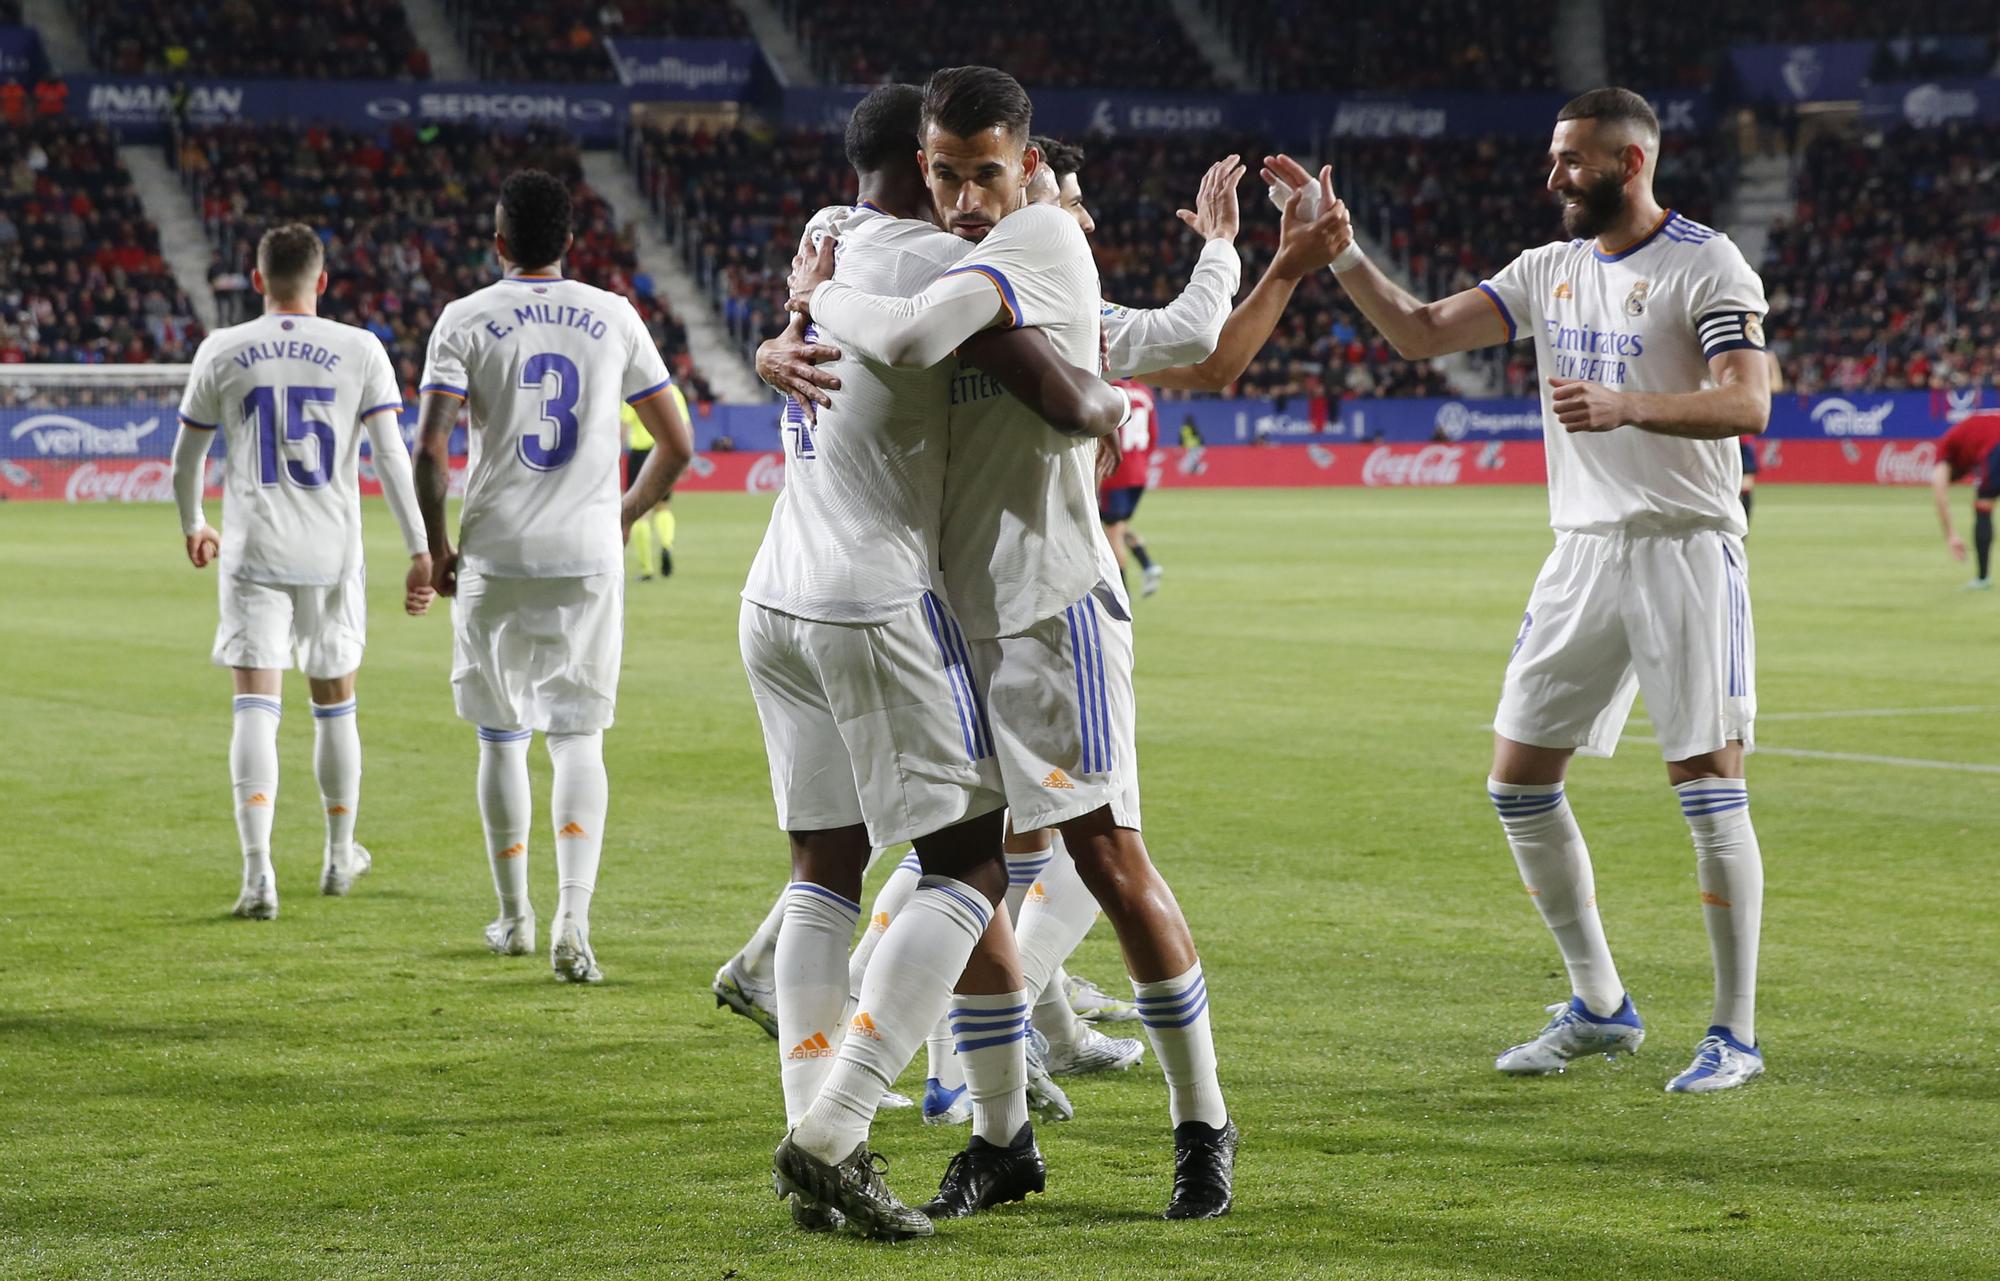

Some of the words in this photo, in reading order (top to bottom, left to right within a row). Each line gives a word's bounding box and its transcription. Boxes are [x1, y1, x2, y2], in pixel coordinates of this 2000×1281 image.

[486, 320, 513, 340] E.
[513, 304, 607, 340] MILITÃO
[1545, 320, 1643, 357] Emirates
[233, 341, 341, 372] VALVERDE
[1556, 354, 1575, 378] FLY
[1579, 356, 1625, 384] BETTER
[951, 374, 1003, 405] ETTER
[516, 353, 579, 472] 3
[241, 386, 336, 490] 15
[1041, 780, 1076, 790] adidas
